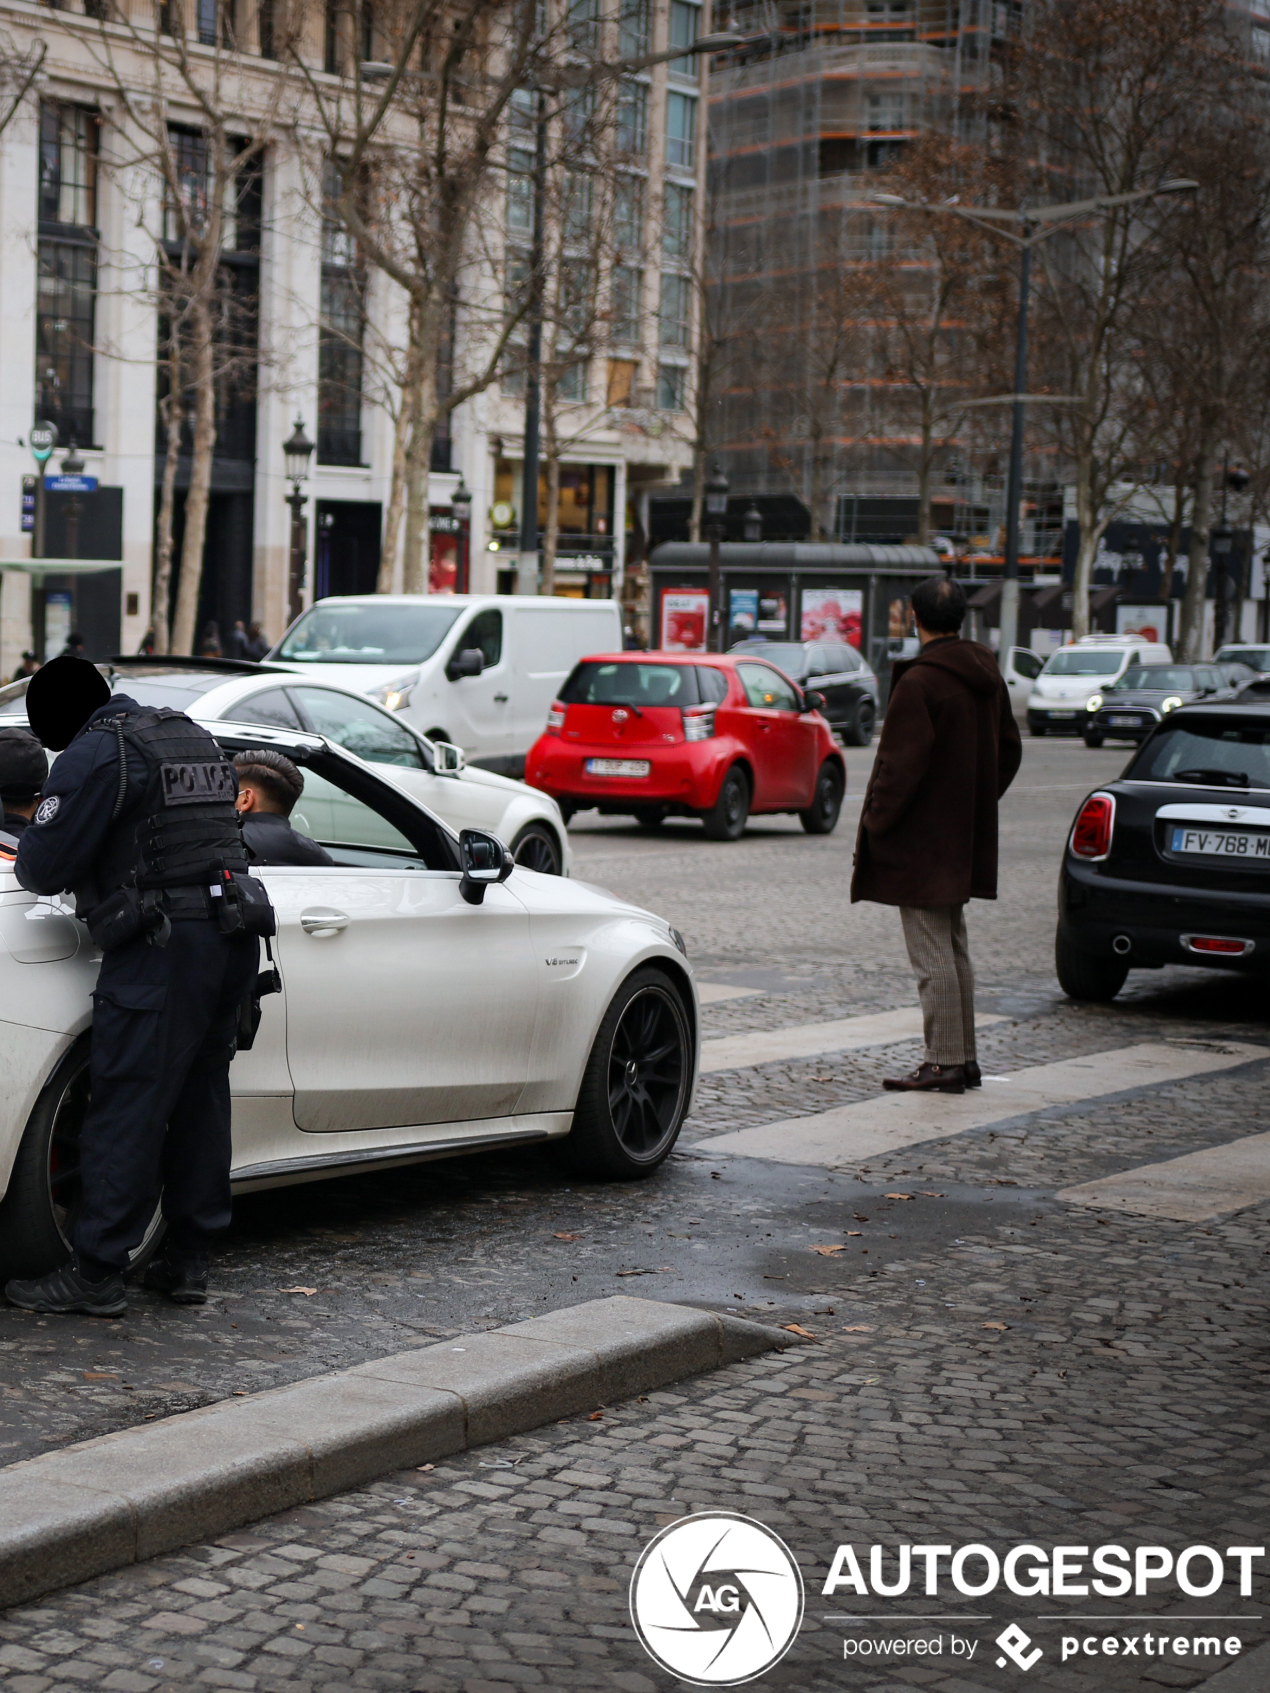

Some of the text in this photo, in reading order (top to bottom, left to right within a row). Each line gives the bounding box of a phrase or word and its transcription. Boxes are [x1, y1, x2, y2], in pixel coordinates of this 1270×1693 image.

[32, 430, 51, 442] BUS
[164, 765, 233, 794] POLICE
[1184, 832, 1270, 858] FV-768-M
[545, 958, 558, 966] V8
